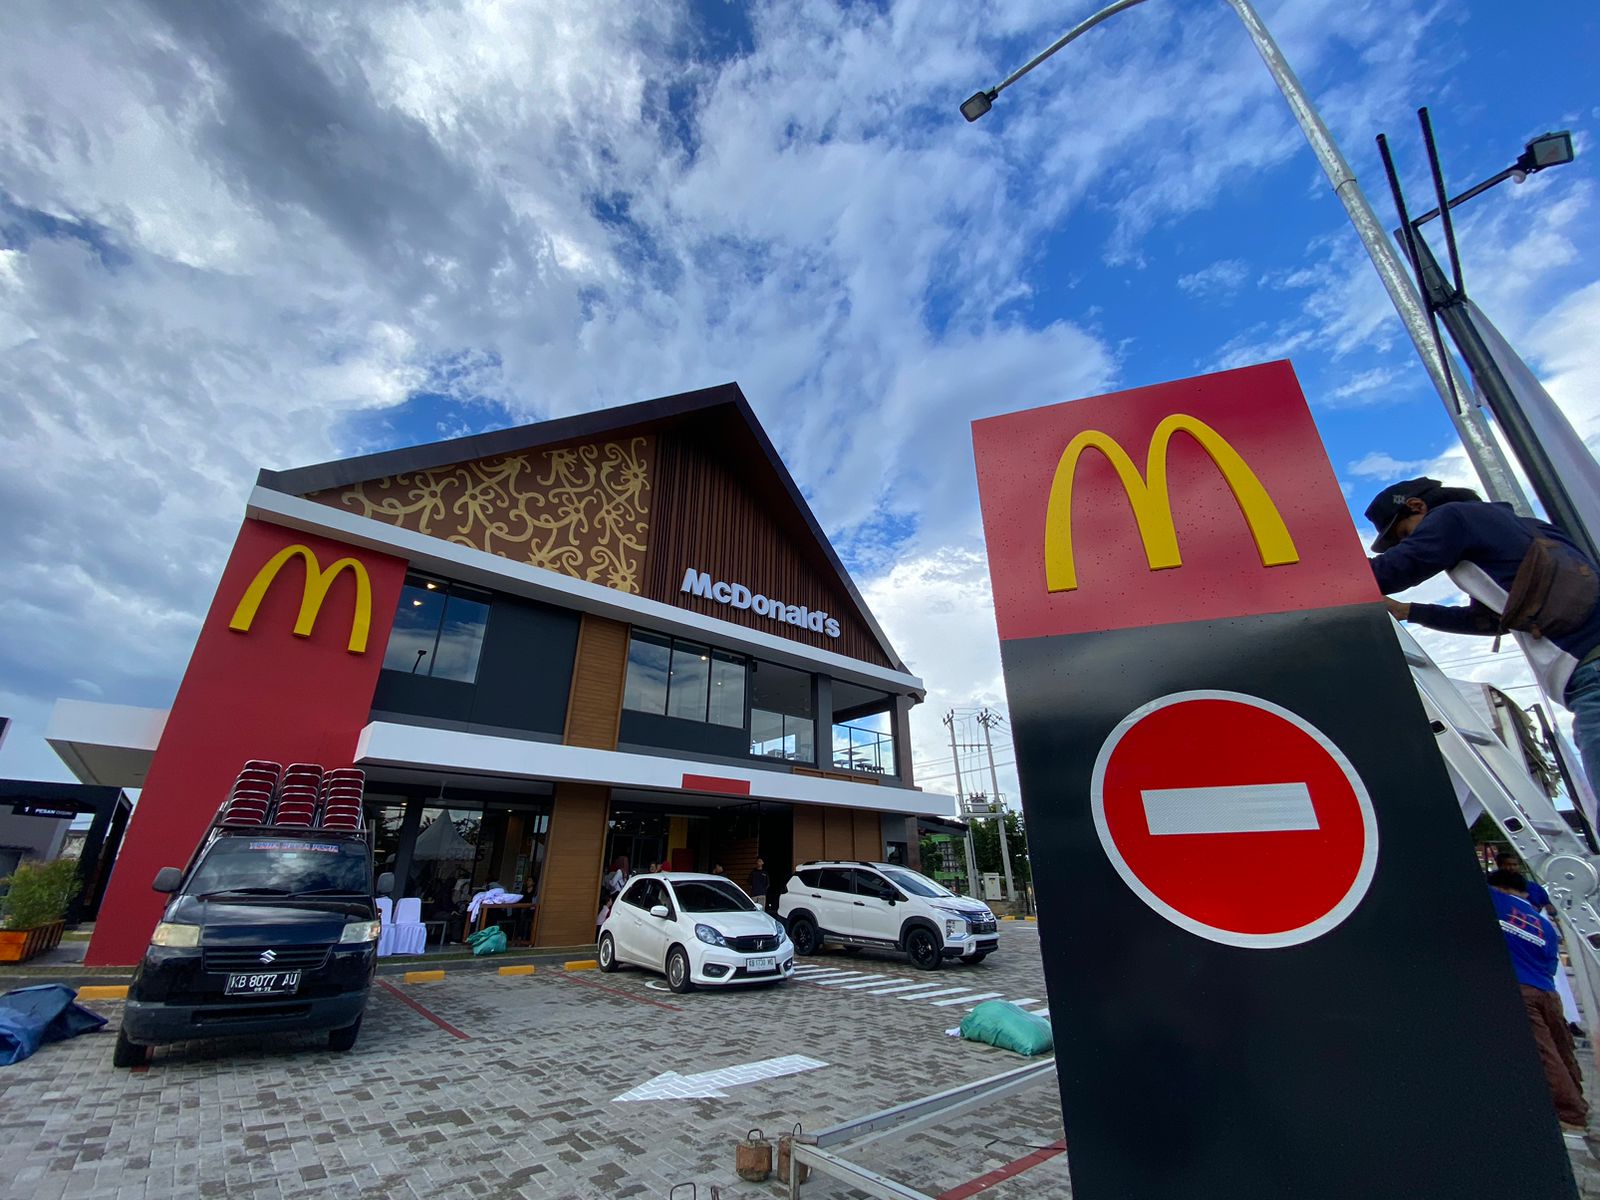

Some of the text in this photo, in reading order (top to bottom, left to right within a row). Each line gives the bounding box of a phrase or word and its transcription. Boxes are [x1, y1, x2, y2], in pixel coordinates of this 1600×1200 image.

[680, 567, 841, 638] McDonald's
[230, 973, 298, 988] KB 8077 AU
